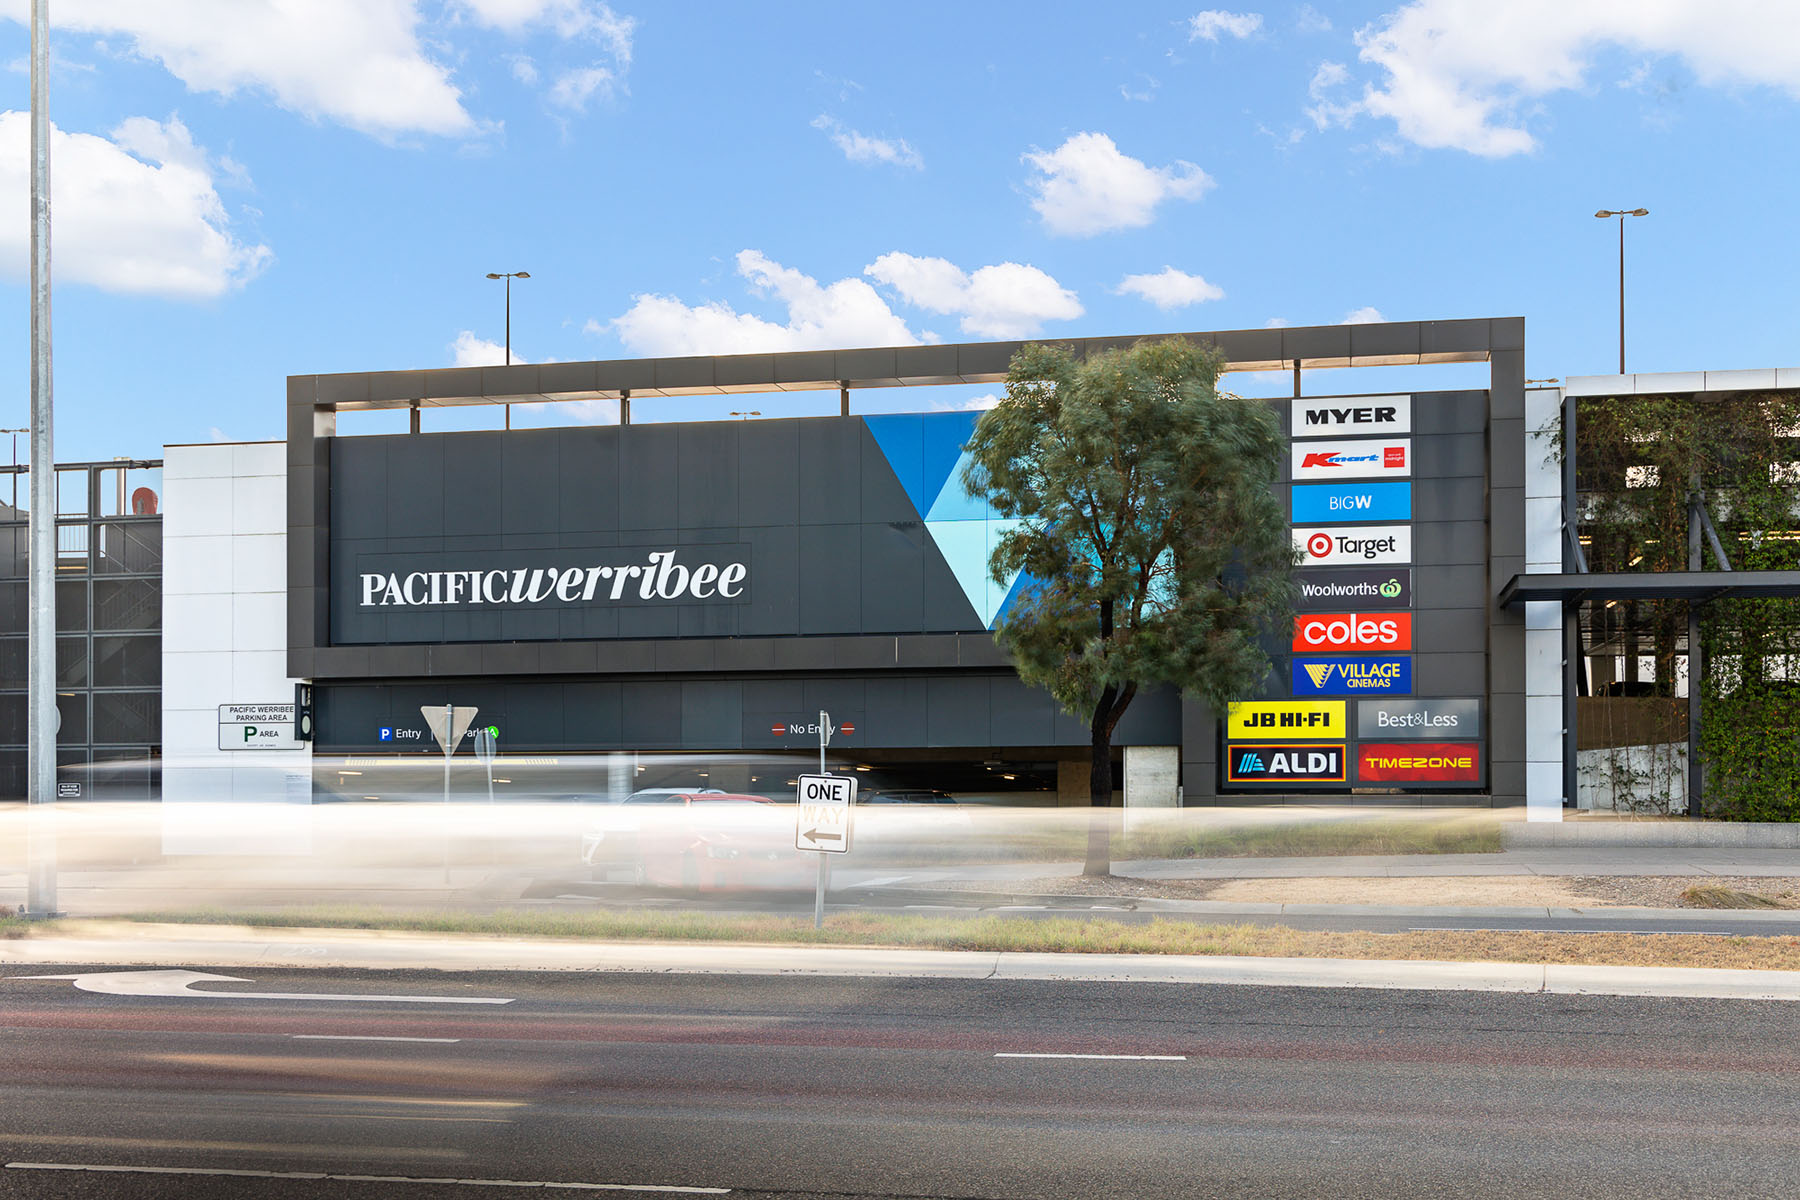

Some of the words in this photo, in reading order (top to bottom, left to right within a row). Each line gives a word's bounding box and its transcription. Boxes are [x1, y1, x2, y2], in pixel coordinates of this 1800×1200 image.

[1306, 407, 1396, 425] MYER
[1301, 452, 1379, 467] Kmart
[1335, 536, 1396, 559] Target
[1302, 583, 1378, 597] Woolworths
[1304, 613, 1398, 644] coles
[1337, 663, 1400, 678] VILLAGE
[1347, 678, 1391, 688] CINEMAS
[1243, 713, 1275, 727] JB
[1378, 711, 1458, 727] Best&Less
[244, 726, 257, 742] P
[396, 729, 421, 739] Entry
[790, 724, 805, 734] No
[808, 724, 836, 735] Eny
[1269, 753, 1336, 773] ALDI
[1366, 757, 1472, 768] TIMEZONE
[807, 783, 842, 801] ONE
[803, 805, 843, 824] WAY
